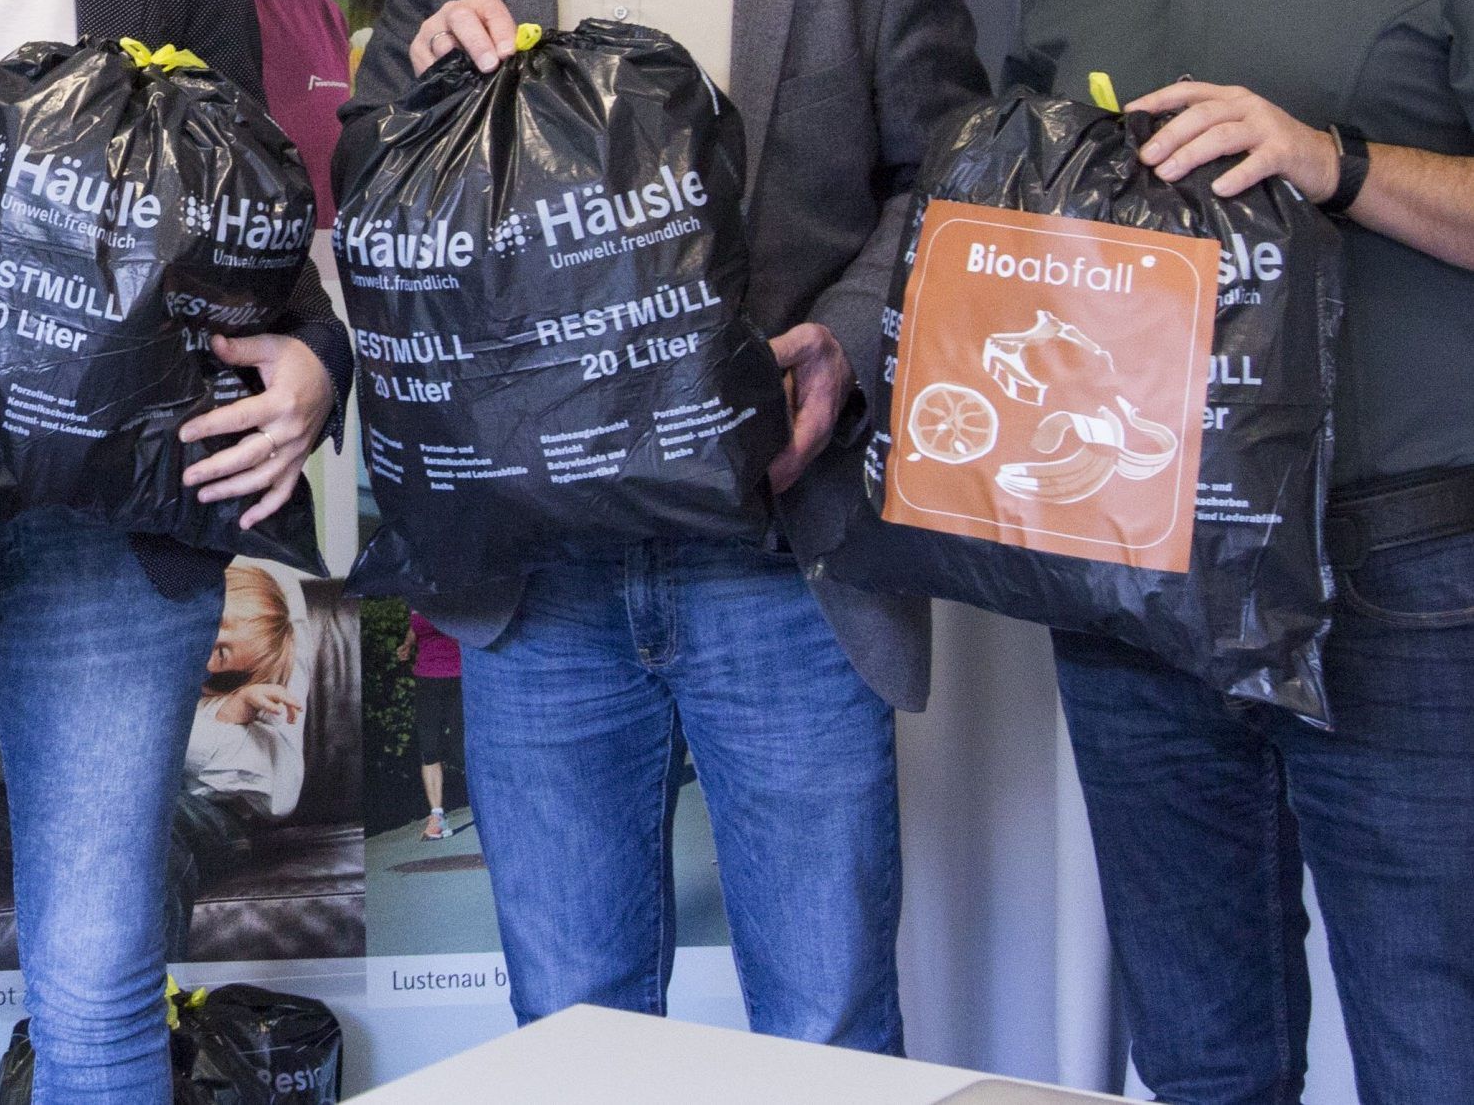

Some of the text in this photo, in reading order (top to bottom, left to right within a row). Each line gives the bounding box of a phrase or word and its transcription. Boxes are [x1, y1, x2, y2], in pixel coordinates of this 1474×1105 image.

[216, 195, 314, 250] Häusl
[535, 164, 708, 248] Häusle
[346, 217, 474, 270] Häusle
[550, 215, 701, 269] Umwelt.freundlich
[966, 242, 1133, 293] Bioabfall
[16, 309, 88, 353] Liter
[535, 280, 722, 346] RESTMÜLL
[354, 329, 474, 363] ESTMÜLL
[581, 331, 700, 381] 20 Liter
[57, 397, 76, 408] und
[391, 377, 453, 403] Liter
[40, 419, 60, 431] und
[393, 970, 486, 990] Lustenau
